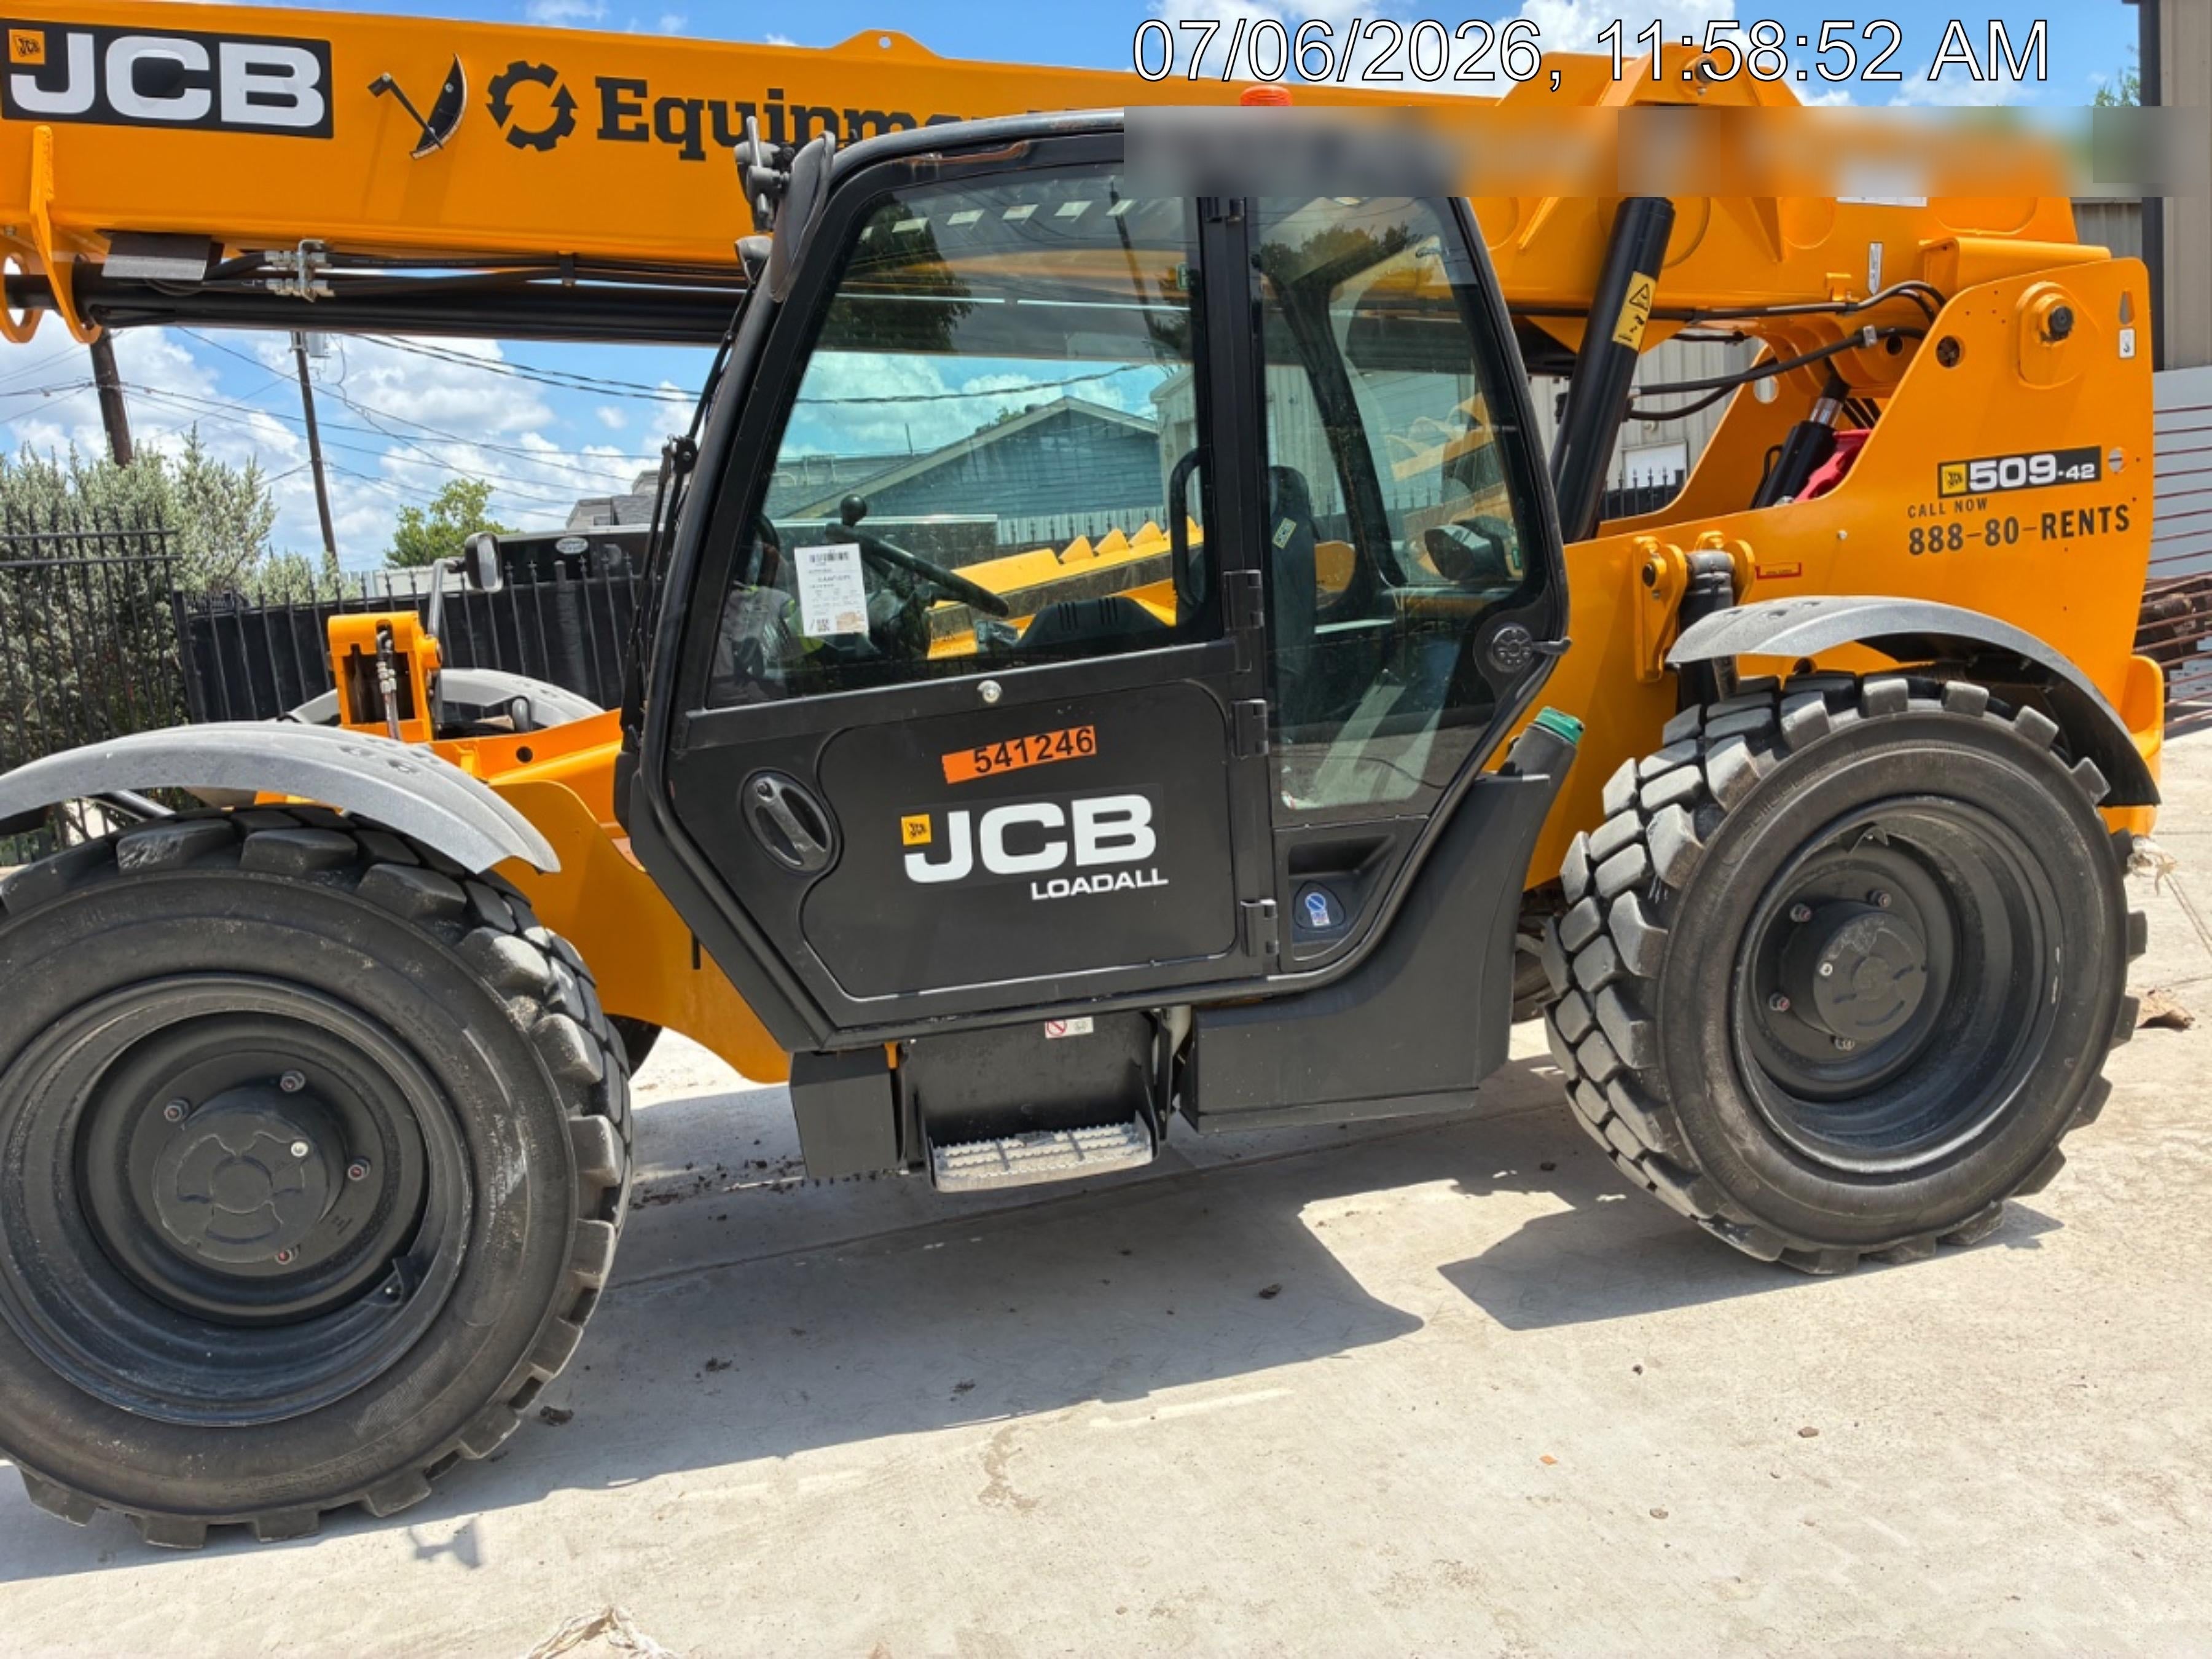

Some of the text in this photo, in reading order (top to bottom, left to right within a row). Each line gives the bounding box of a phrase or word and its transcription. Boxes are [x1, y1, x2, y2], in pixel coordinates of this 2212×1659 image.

[10, 32, 325, 128] JCB
[1907, 497, 1988, 519] CALL NOW
[1908, 504, 2130, 556] 888-80-RENTS
[973, 726, 1094, 774] 541246
[903, 793, 1157, 884] JCB
[1030, 868, 1169, 901] LOADALL
